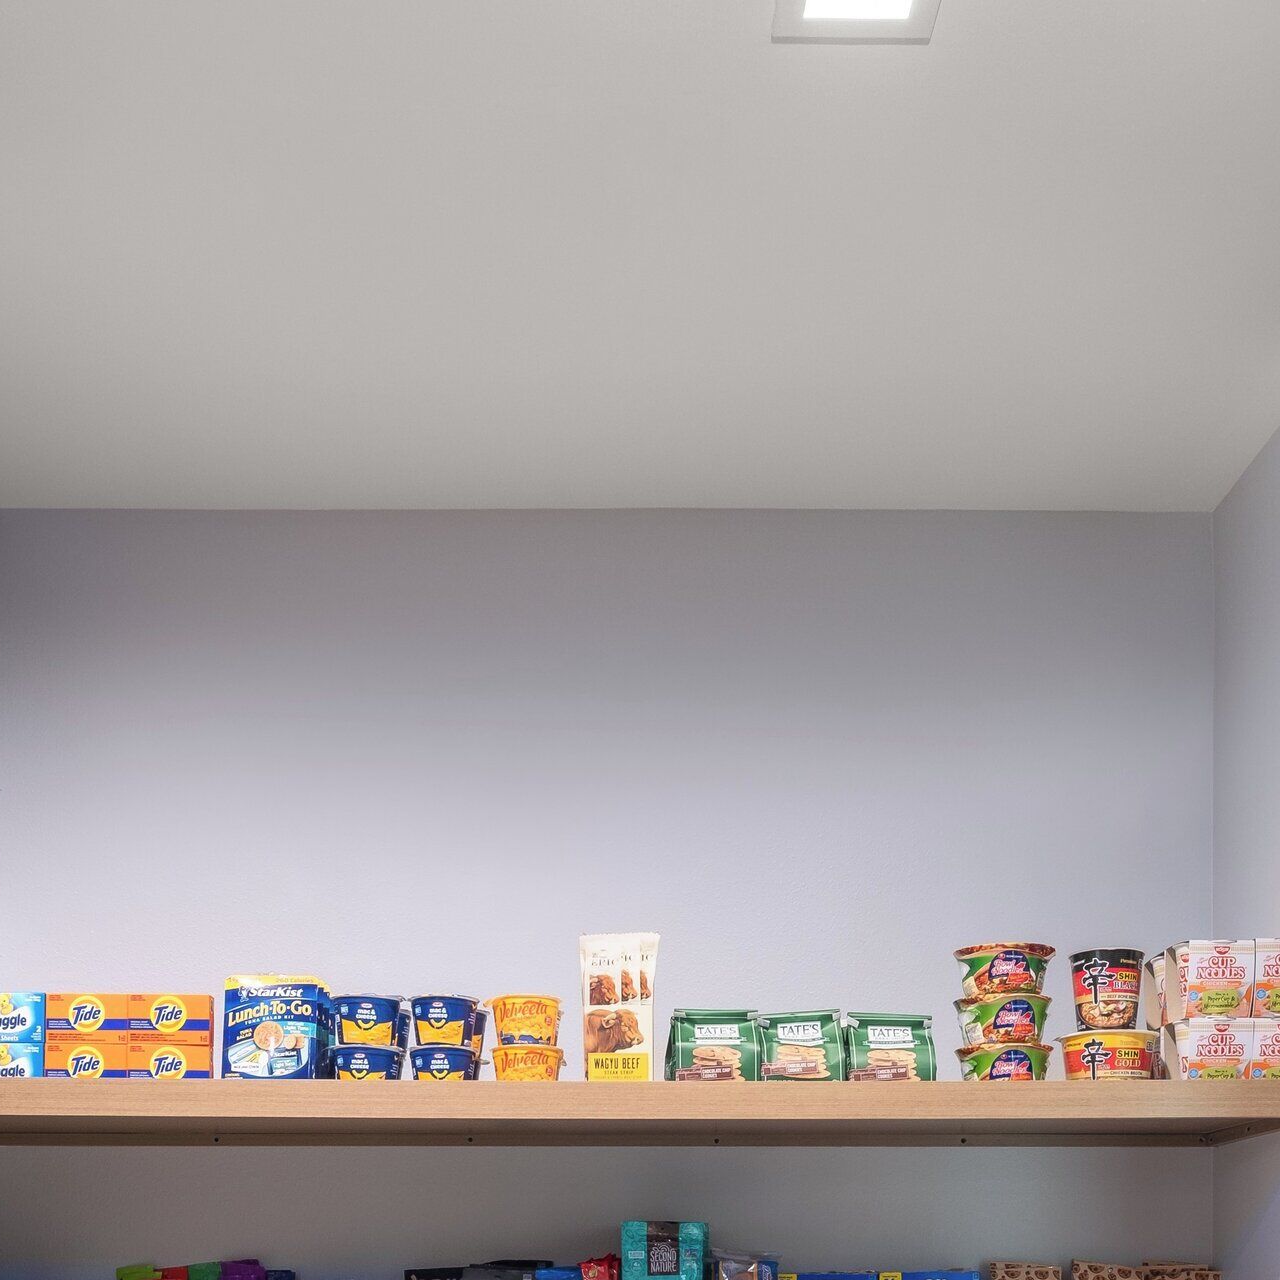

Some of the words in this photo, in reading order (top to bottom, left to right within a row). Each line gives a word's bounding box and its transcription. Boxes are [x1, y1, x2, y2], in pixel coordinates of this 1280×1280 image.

[1208, 955, 1236, 968] CUP
[991, 964, 1025, 976] Noodles
[1118, 972, 1138, 980] SHIN
[1196, 966, 1246, 980] NOODLES
[1082, 958, 1117, 1005] 辛
[249, 986, 303, 997] StarKist
[73, 1005, 101, 1025] Tide
[154, 1005, 182, 1025] Tide
[498, 999, 548, 1020] Velveeta
[996, 1015, 1030, 1025] Noodles
[697, 1026, 737, 1036] TATE'S
[779, 1023, 820, 1037] TATE'S
[870, 1027, 910, 1039] TATE'S
[1208, 1033, 1235, 1046] CUP
[1117, 1050, 1139, 1058] SHIN
[1196, 1044, 1244, 1057] NOODLES
[72, 1055, 100, 1076] Tide
[154, 1055, 182, 1076] Tide
[501, 1050, 550, 1071] Velveeta
[594, 1057, 619, 1069] WAGYU
[621, 1057, 640, 1069] BEEF
[1081, 1038, 1111, 1080] 辛
[1114, 1059, 1141, 1067] GOLD
[992, 1065, 1027, 1076] Noodles
[649, 1251, 677, 1263] SECOND
[650, 1262, 677, 1273] NATURE
